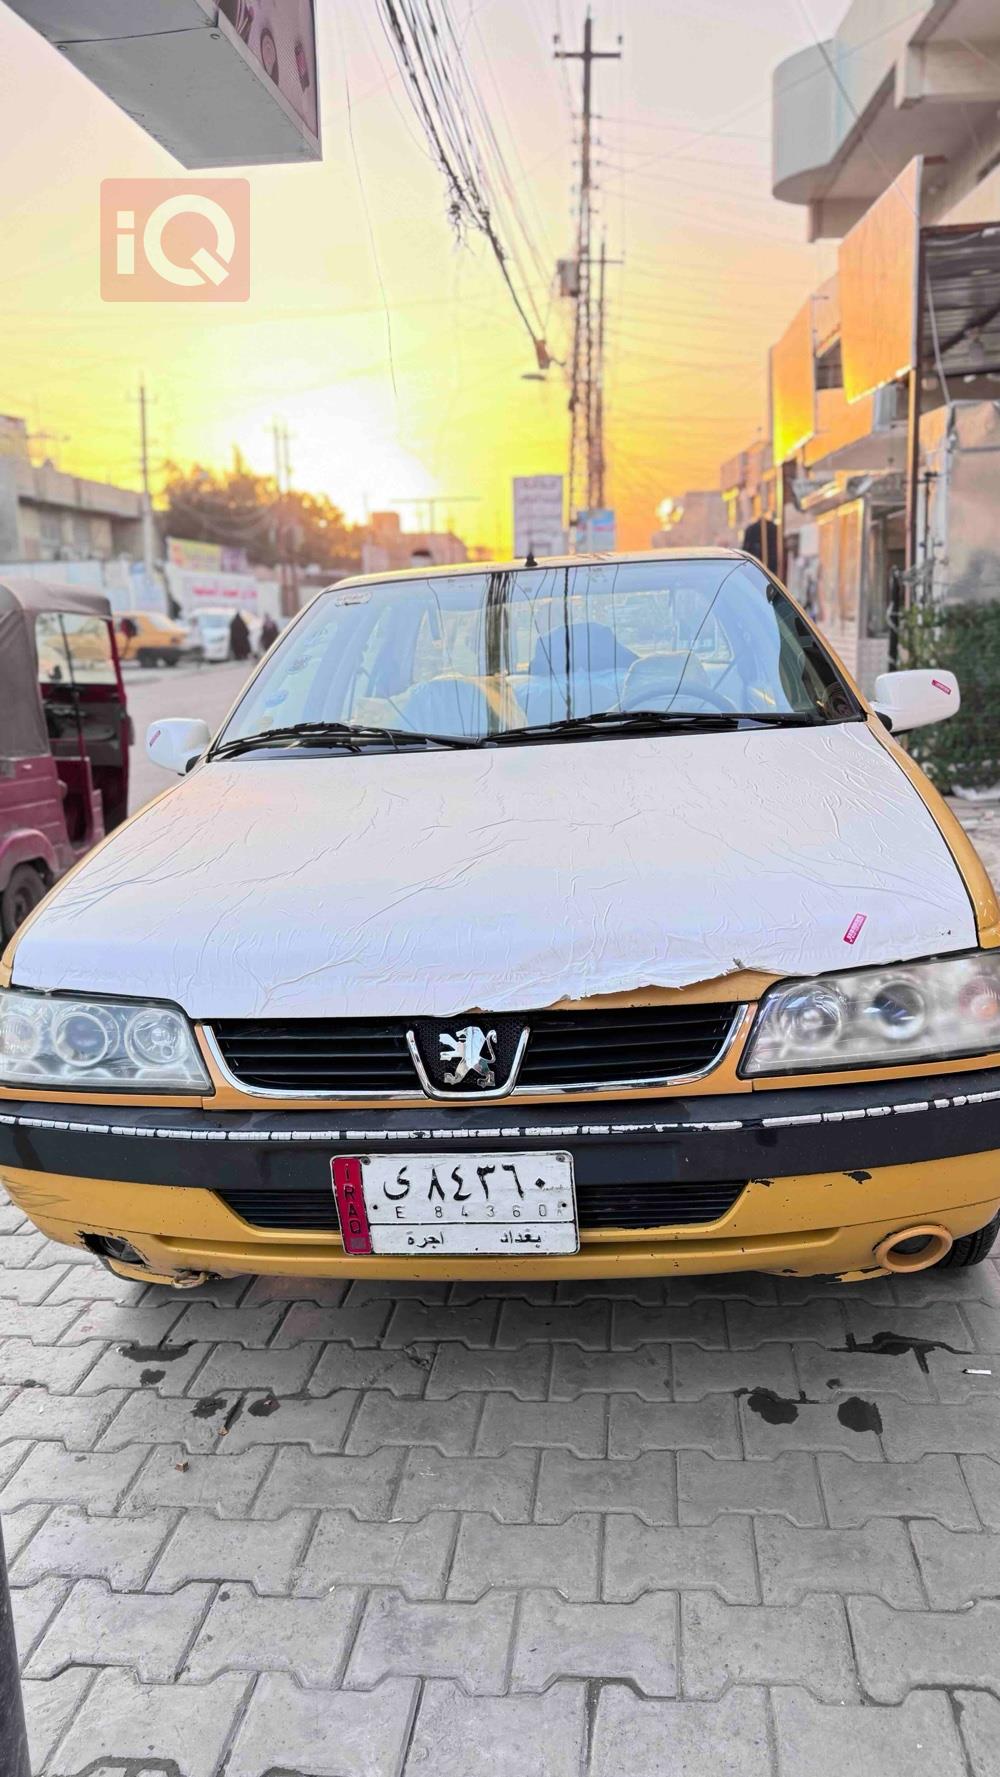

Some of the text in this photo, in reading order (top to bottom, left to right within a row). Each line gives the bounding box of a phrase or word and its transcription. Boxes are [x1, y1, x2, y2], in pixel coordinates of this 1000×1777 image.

[343, 1162, 362, 1234] IRAQ
[395, 1206, 406, 1219] E
[500, 1228, 542, 1248] بغداد
